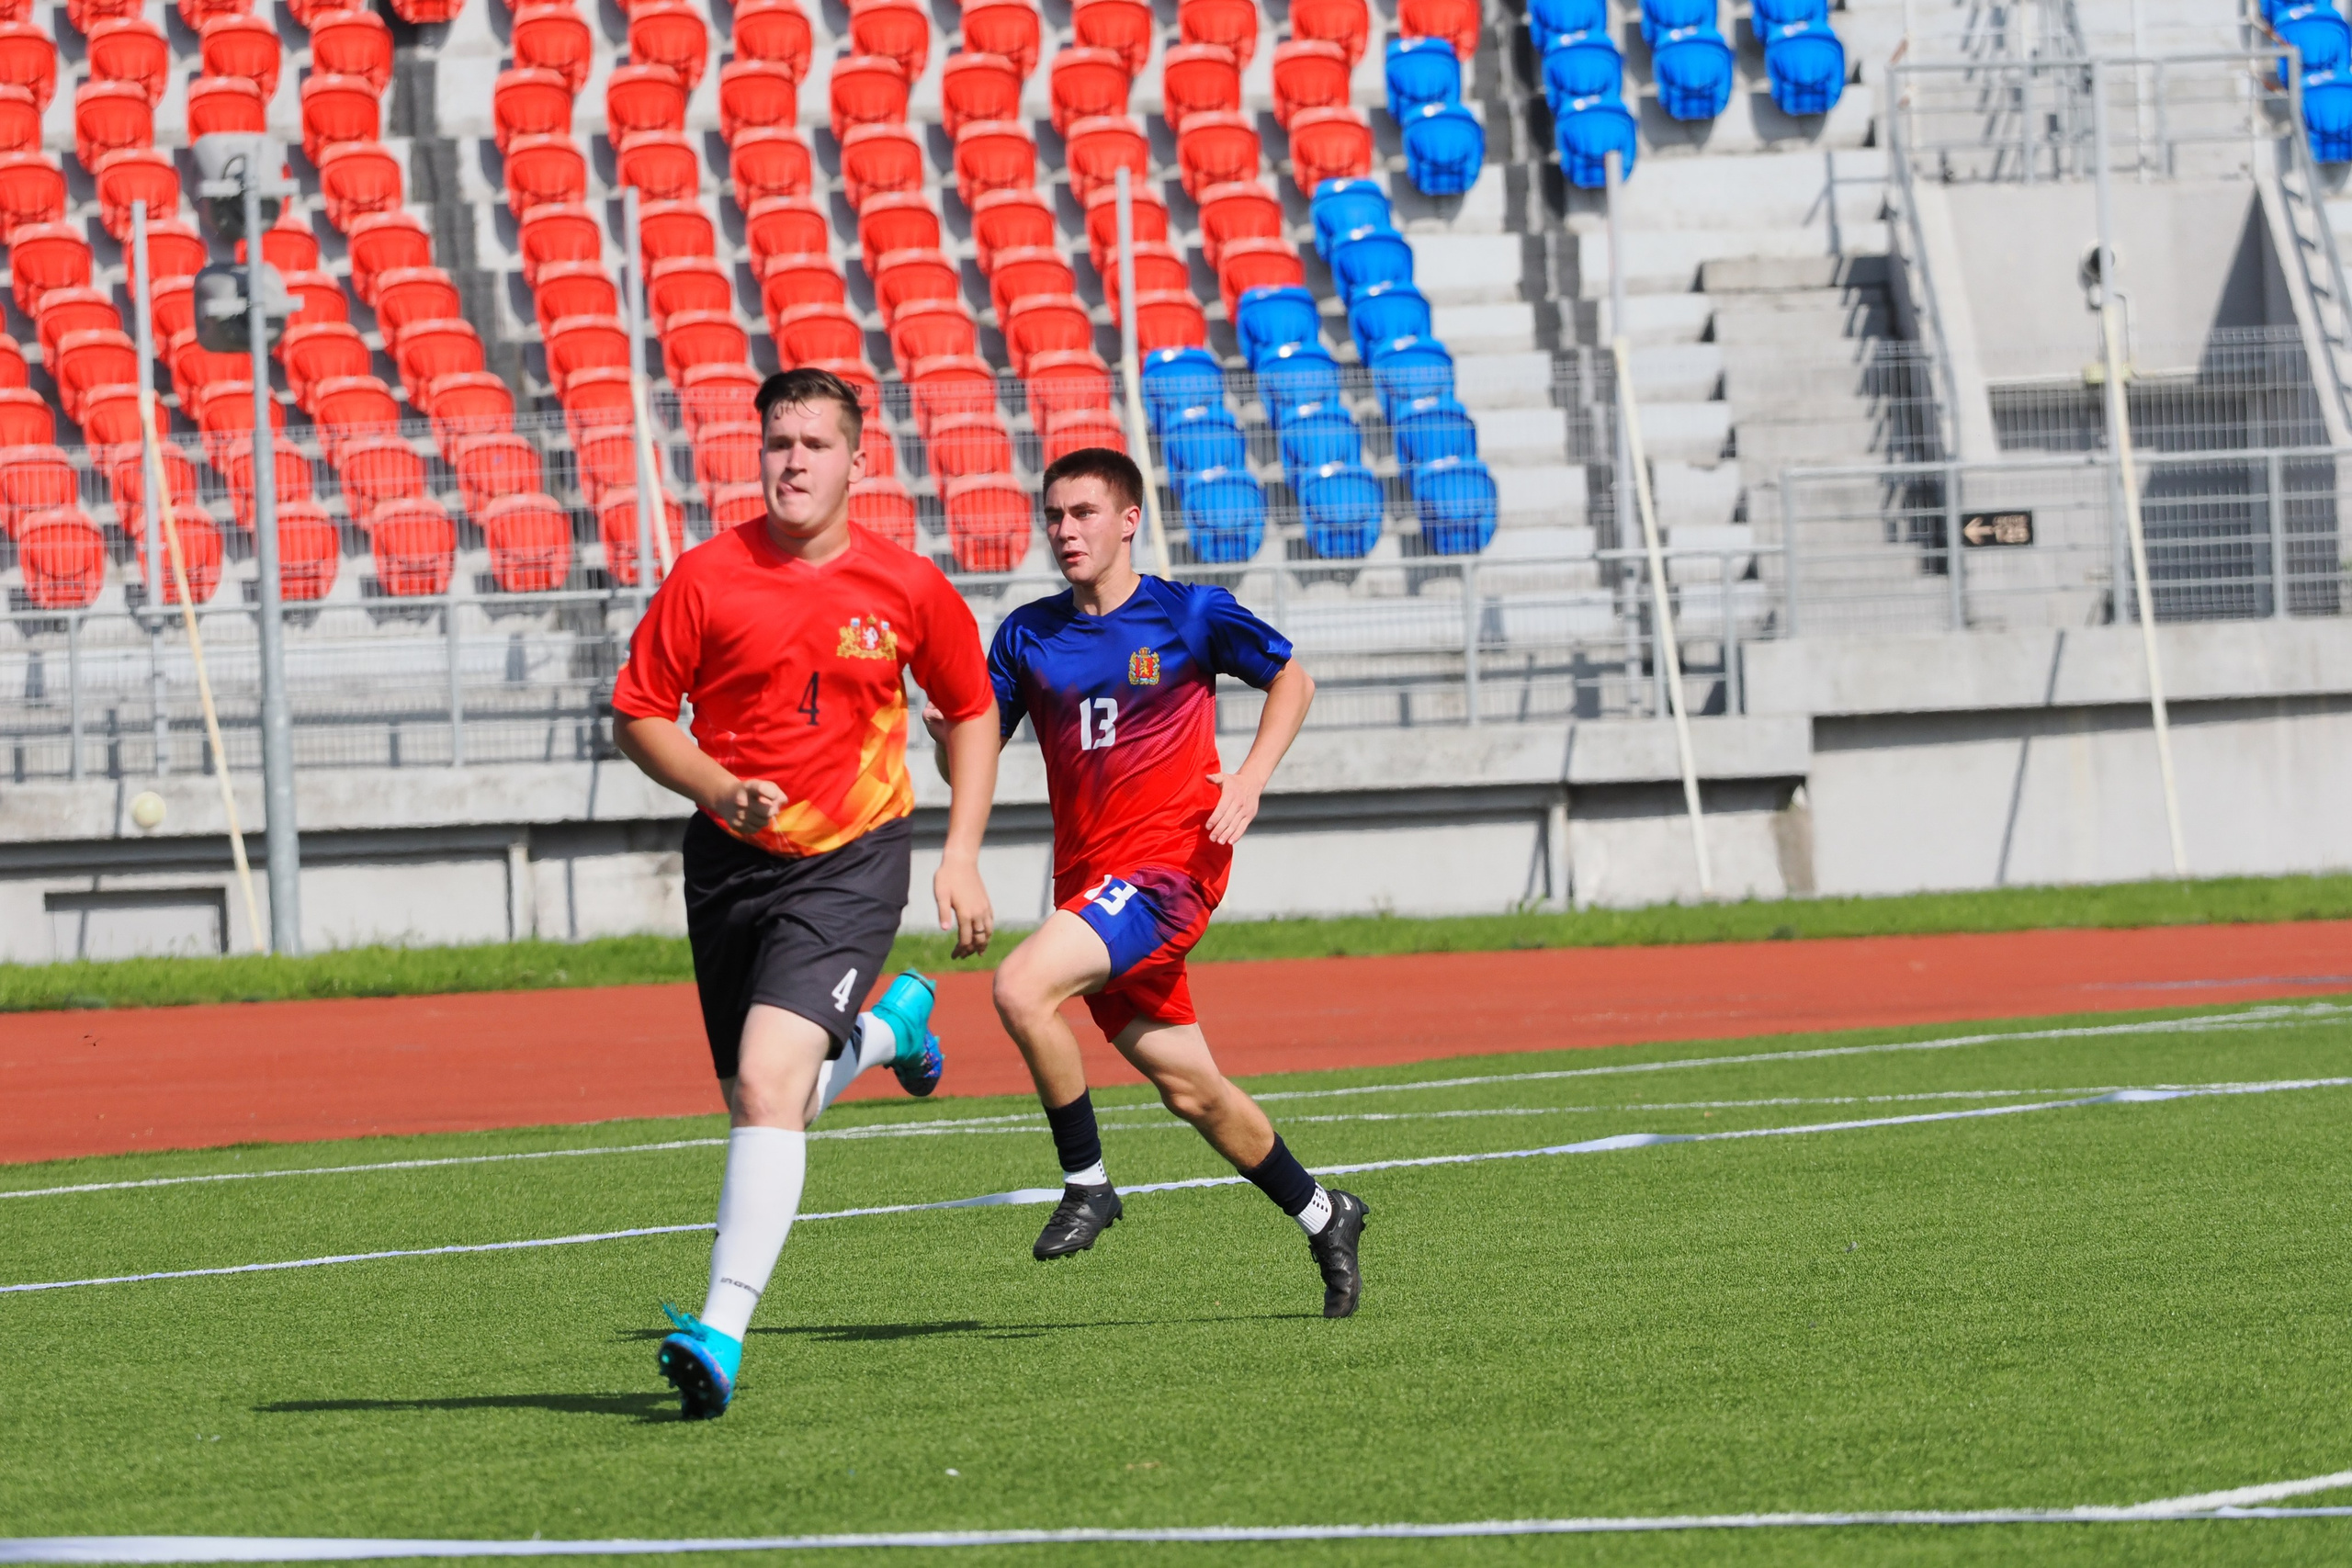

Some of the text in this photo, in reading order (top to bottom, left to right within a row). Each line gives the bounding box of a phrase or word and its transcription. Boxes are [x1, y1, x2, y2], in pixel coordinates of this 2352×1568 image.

[797, 671, 820, 726] 4
[1079, 697, 1118, 750] 13
[1084, 874, 1138, 916] 13
[831, 967, 858, 1013] 4
